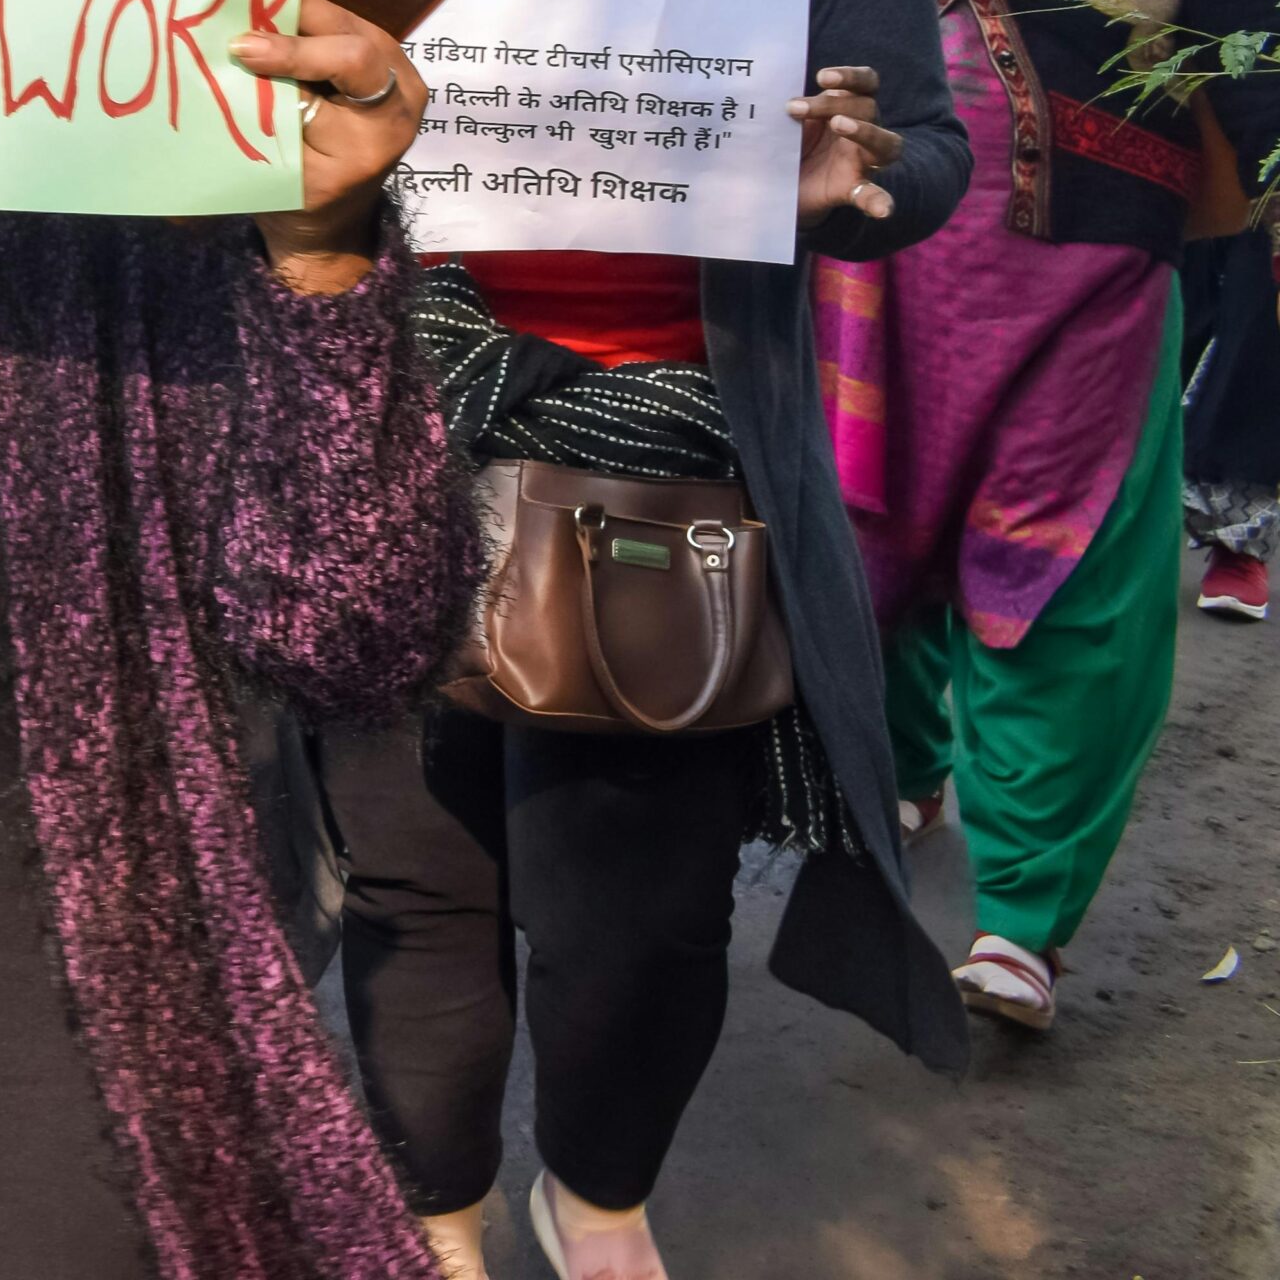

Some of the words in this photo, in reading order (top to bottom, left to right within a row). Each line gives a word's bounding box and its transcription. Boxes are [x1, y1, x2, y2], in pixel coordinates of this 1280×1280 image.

[423, 37, 487, 63] इंडिया
[494, 40, 539, 66] गेस्ट
[546, 44, 612, 71] टीचर्स
[618, 48, 754, 79] एसोसिएशन
[445, 82, 510, 108] दिल्ली
[517, 86, 541, 109] के
[549, 89, 629, 114] अतिथि
[636, 92, 714, 117] शिक्षक
[721, 96, 738, 121] है
[545, 120, 575, 141] भी
[588, 127, 637, 150] खुश
[644, 126, 687, 150] नही
[393, 162, 472, 194] दिल्ली
[481, 167, 582, 198] अतिथि
[590, 171, 689, 203] शिक्षक
